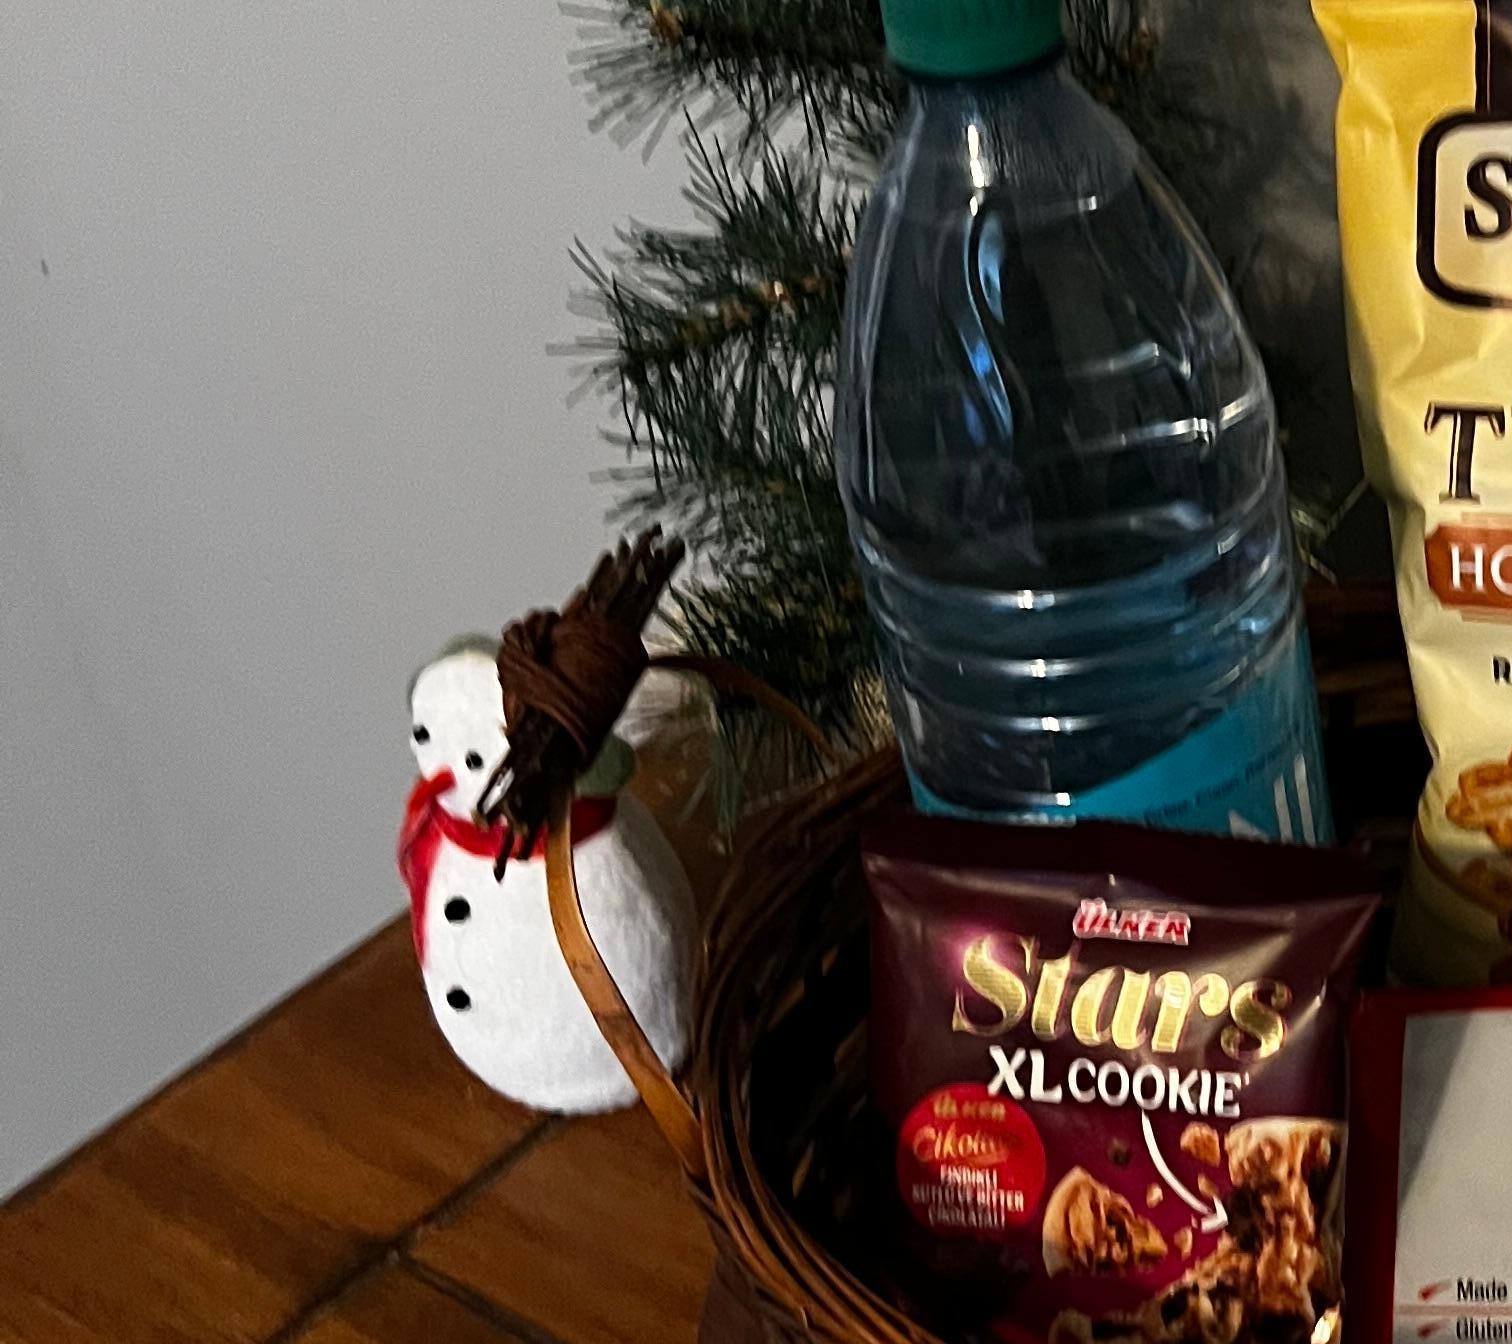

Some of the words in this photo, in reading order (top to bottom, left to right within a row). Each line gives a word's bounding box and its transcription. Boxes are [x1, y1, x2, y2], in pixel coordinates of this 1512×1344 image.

[951, 934, 1293, 1060] Stars
[987, 1046, 1063, 1103] XL
[1067, 1058, 1243, 1118] COOKIE
[1457, 1277, 1508, 1302] Made
